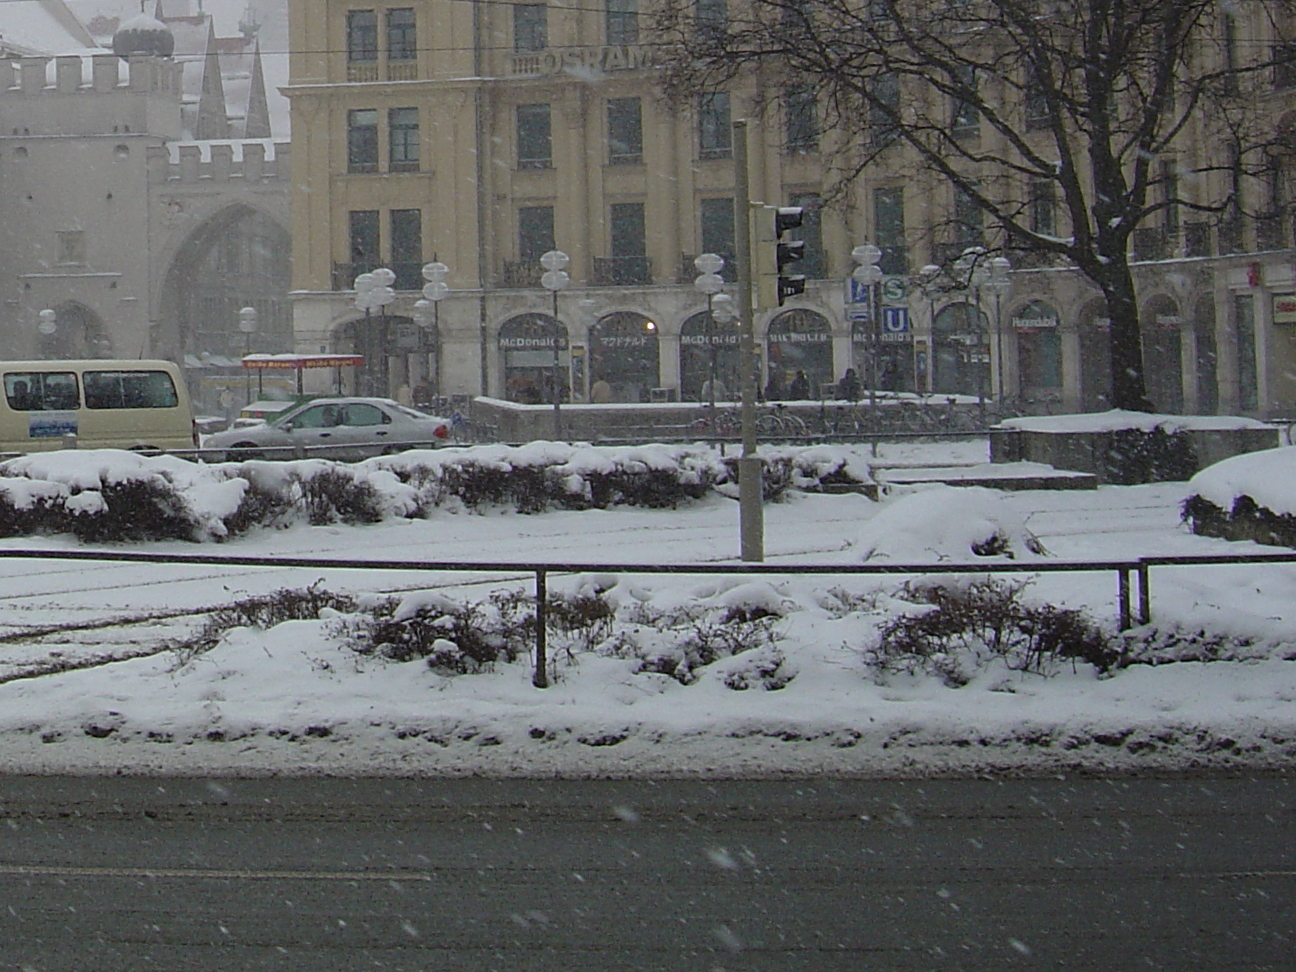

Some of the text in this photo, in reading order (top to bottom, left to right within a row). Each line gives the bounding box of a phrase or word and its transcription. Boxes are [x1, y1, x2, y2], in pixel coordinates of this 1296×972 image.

[542, 45, 652, 74] OSRAM
[886, 310, 904, 332] U
[499, 337, 566, 347] McDonals
[681, 334, 742, 345] McDonald
